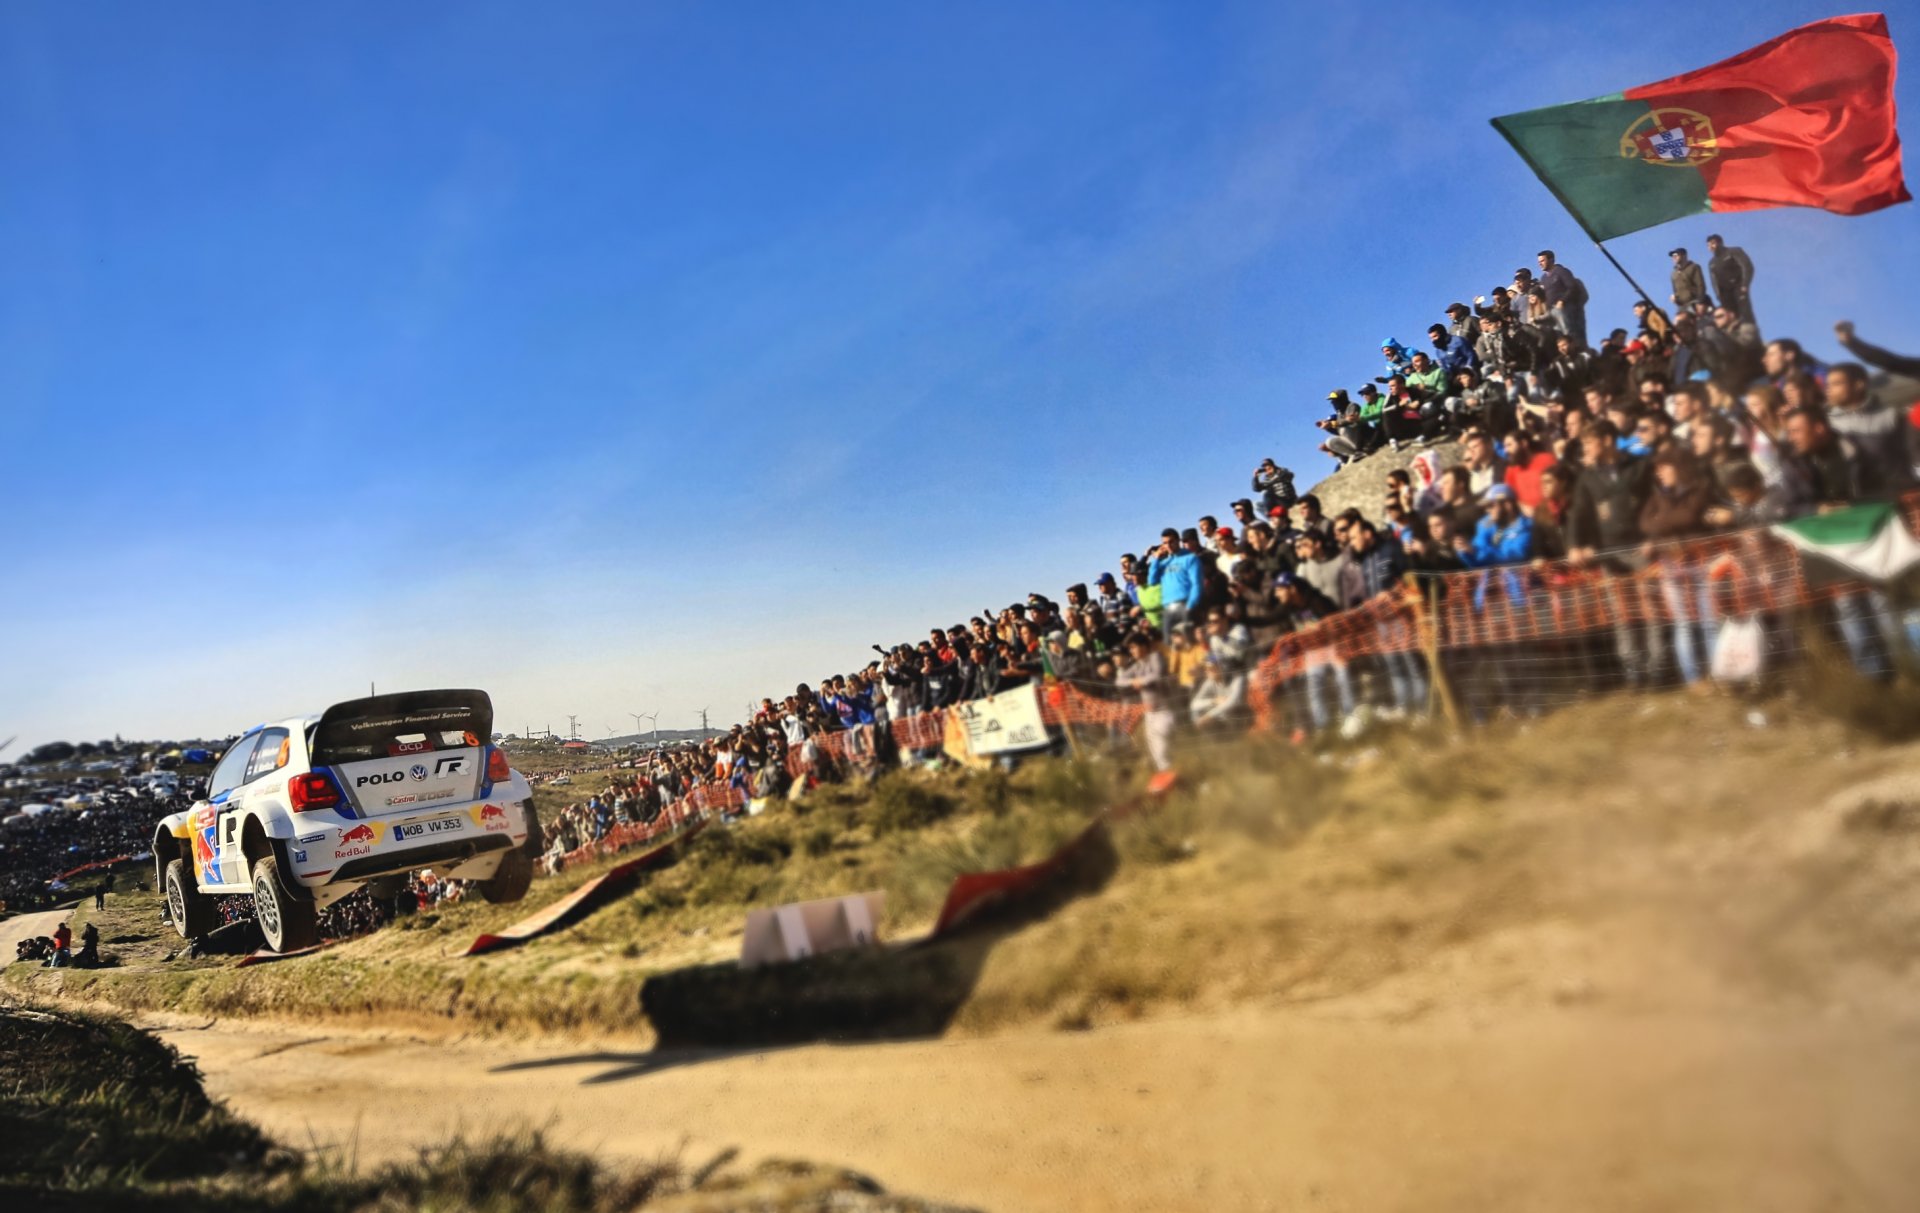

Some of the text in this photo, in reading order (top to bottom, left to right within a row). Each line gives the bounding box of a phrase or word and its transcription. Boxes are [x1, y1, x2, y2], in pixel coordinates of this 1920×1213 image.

[350, 710, 471, 731] Volkswagen Financial Services
[398, 742, 424, 753] acp
[463, 731, 480, 747] 8
[356, 771, 405, 788] POLO
[392, 788, 456, 805] Castrol EDGE
[402, 818, 462, 836] WOB VW 353
[335, 845, 371, 859] Red Bull
